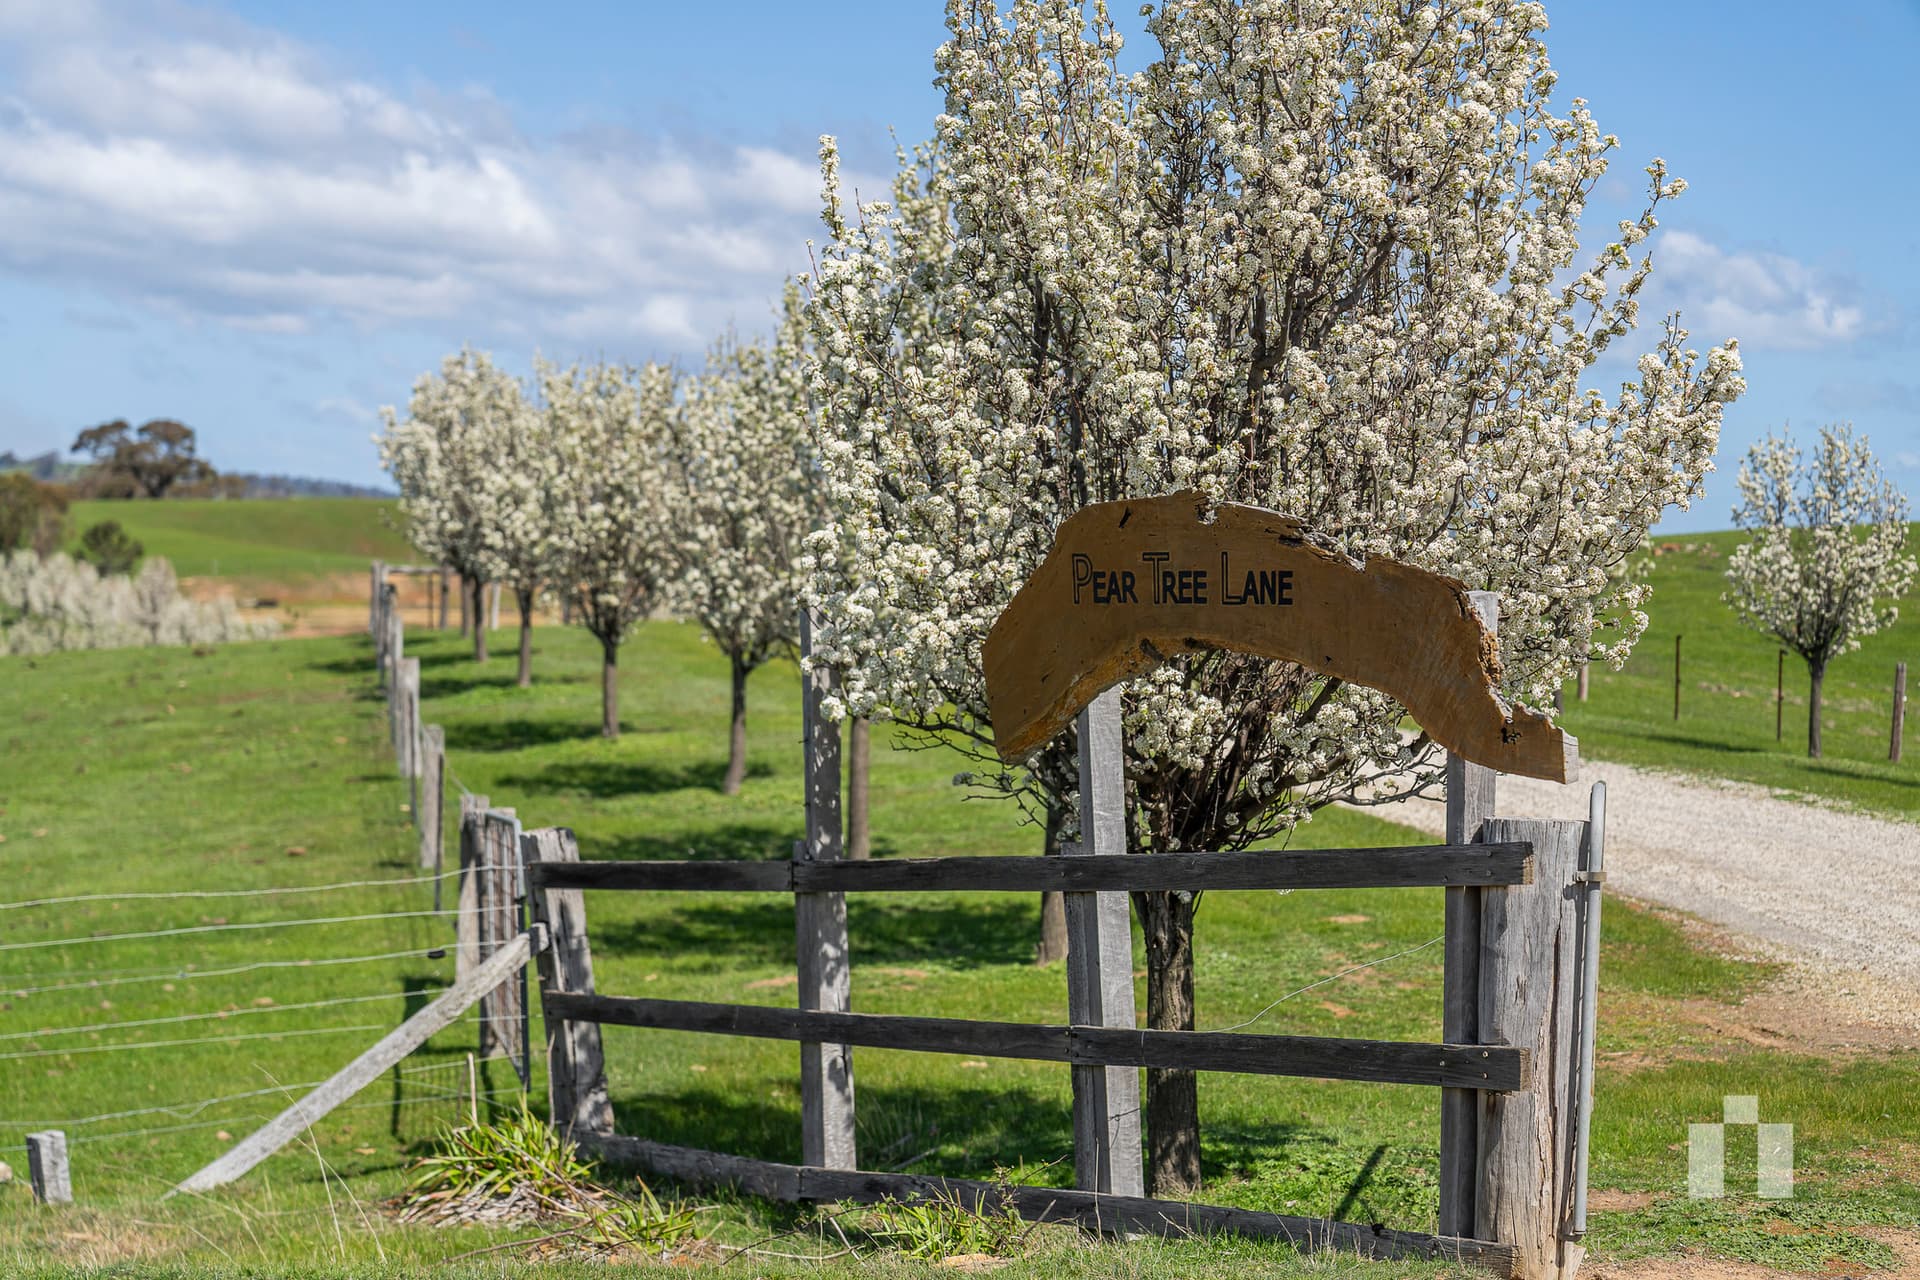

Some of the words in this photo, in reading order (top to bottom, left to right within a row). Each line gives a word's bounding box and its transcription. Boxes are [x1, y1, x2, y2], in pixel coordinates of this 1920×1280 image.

[1072, 553, 1138, 604] PEAR
[1142, 552, 1207, 604] TREE
[1221, 551, 1293, 605] LANE
